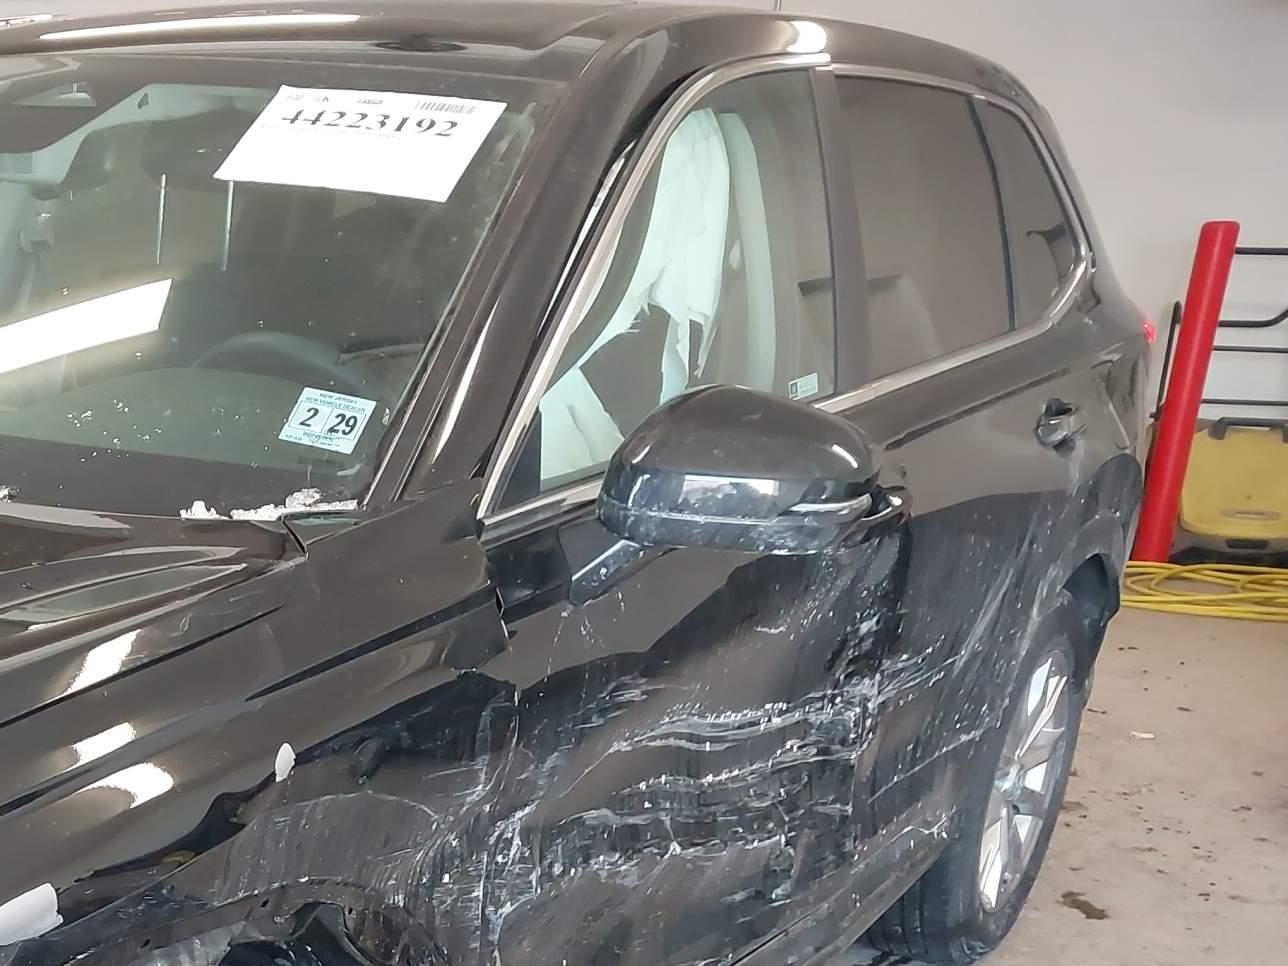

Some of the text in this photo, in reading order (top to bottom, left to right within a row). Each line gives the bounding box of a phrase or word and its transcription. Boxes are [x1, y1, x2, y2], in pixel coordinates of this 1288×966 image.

[281, 109, 458, 137] 44223192
[299, 407, 358, 435] 2 29
